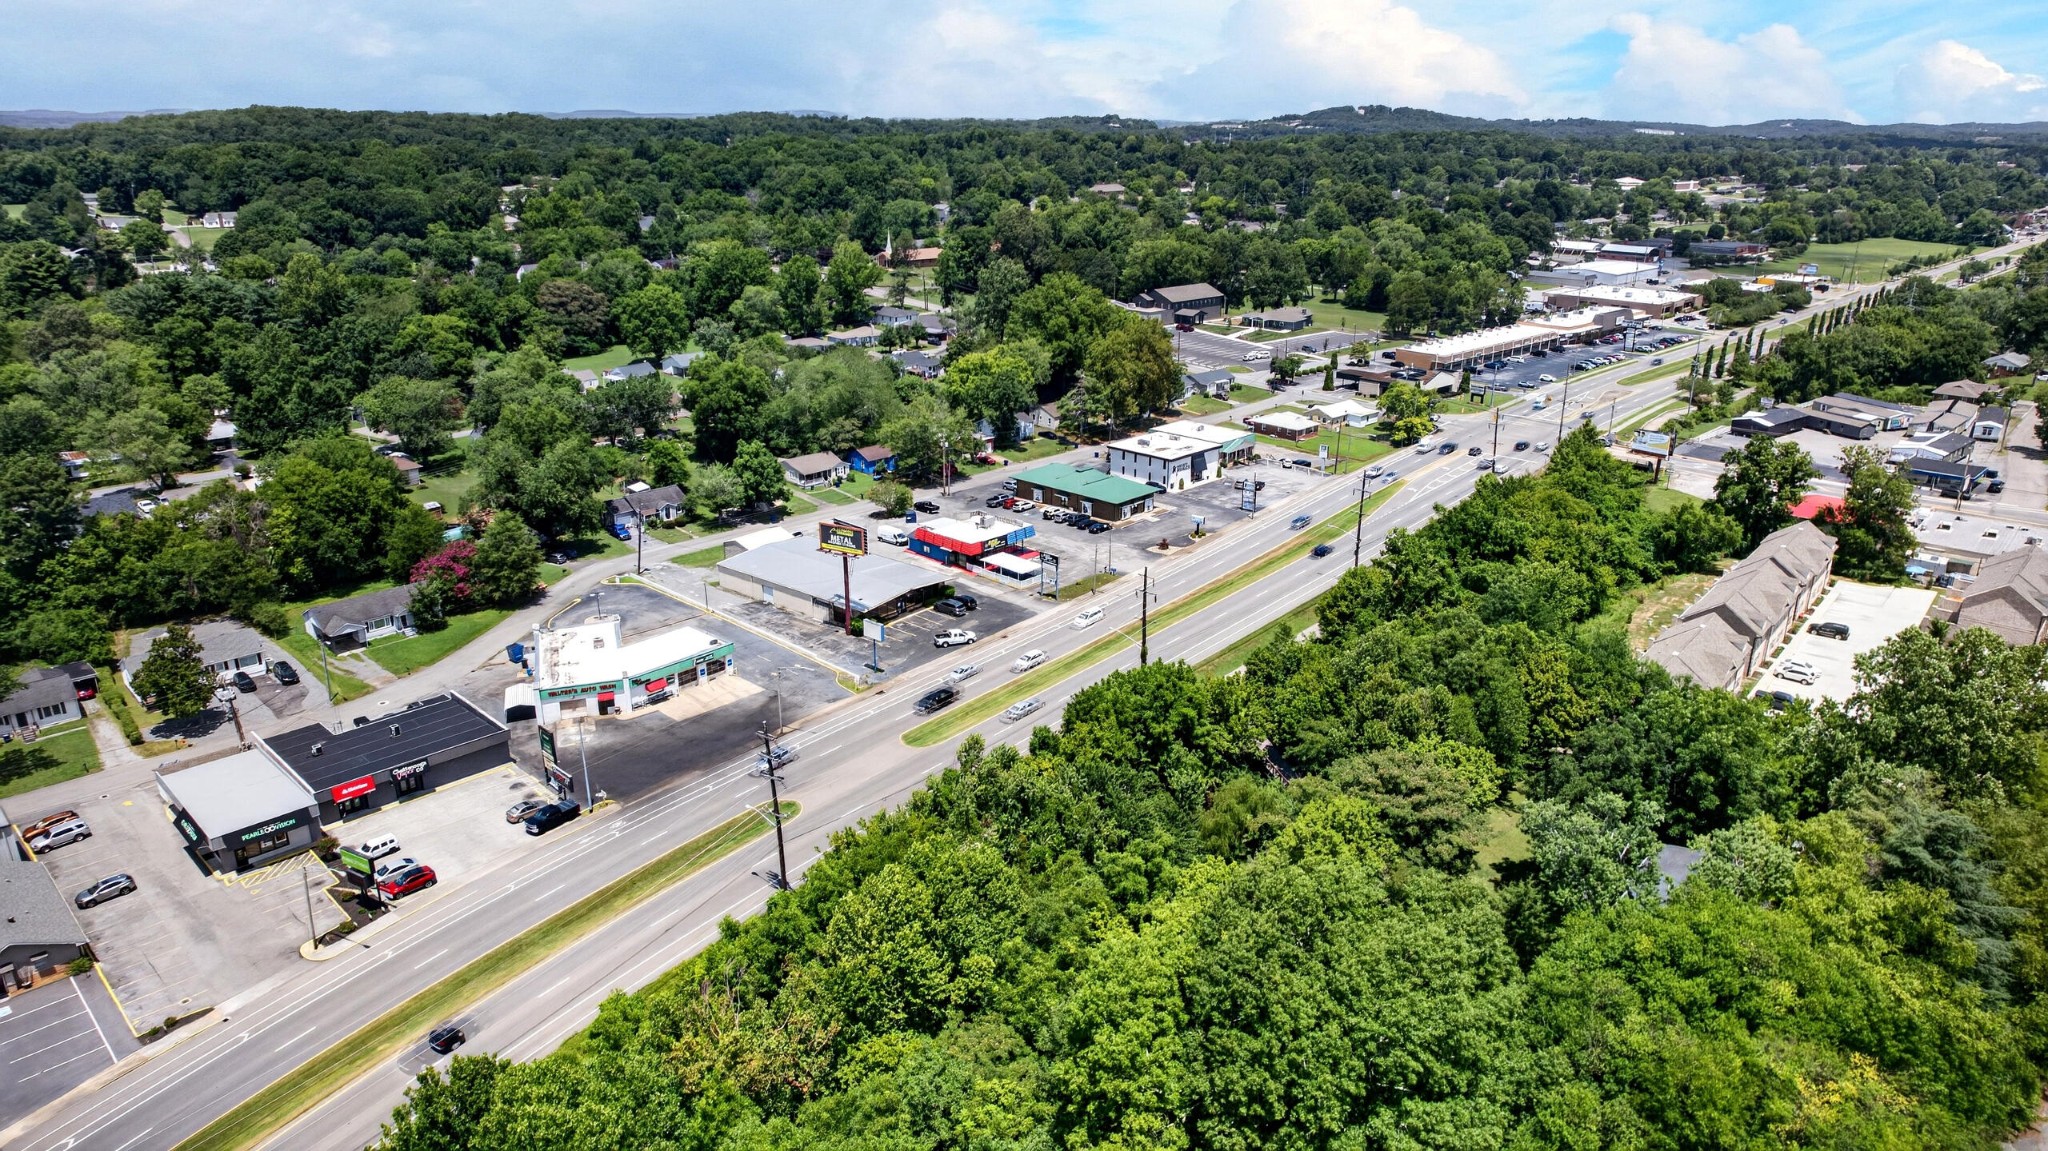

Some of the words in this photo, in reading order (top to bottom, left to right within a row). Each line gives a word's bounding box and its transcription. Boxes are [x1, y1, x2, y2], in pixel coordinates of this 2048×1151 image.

[830, 534, 853, 545] METAL
[241, 829, 265, 841] PEARLE
[275, 818, 296, 830] VISION
